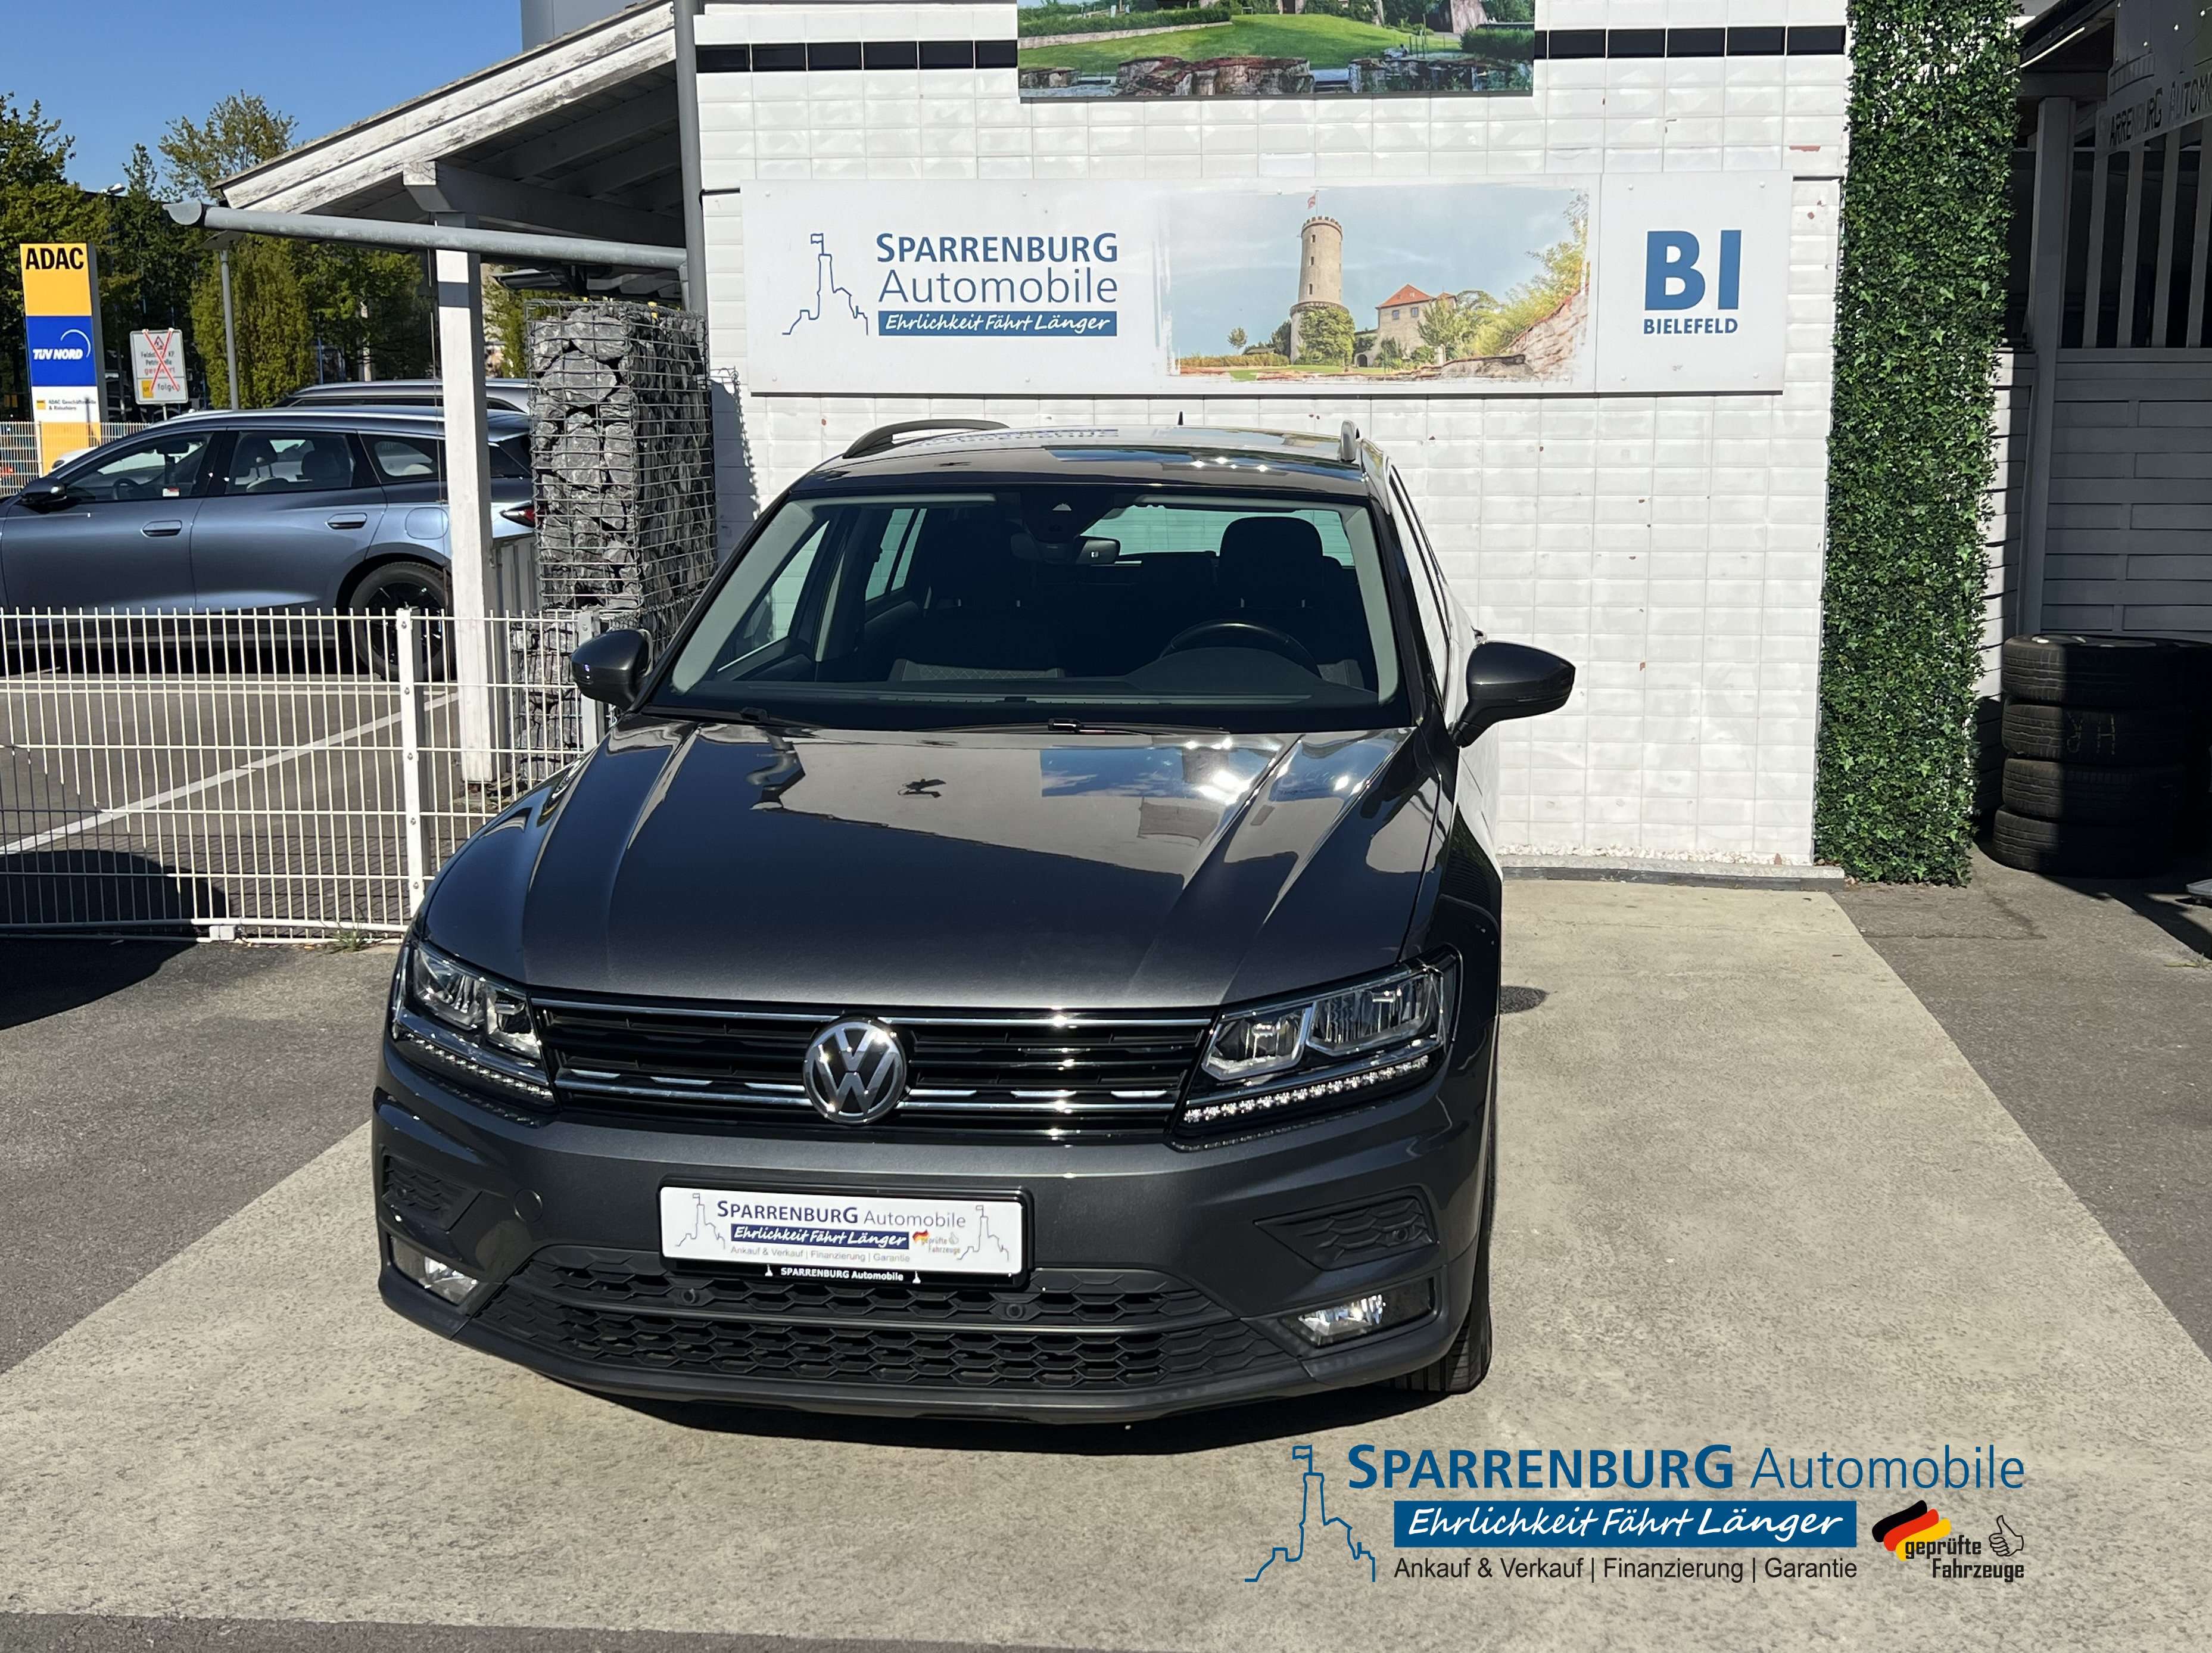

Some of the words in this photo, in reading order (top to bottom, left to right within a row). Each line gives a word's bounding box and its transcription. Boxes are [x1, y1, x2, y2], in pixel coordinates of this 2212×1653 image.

[26, 247, 84, 270] ADAC
[877, 233, 1118, 263] SPARRENBURG
[1645, 230, 1741, 311] BI
[878, 267, 1118, 303] Automobile
[885, 313, 985, 331] Ehrlichkeit
[985, 314, 1033, 331] Fährt
[1034, 314, 1110, 334] Länger
[1644, 318, 1738, 334] BIELEFELD
[33, 348, 53, 360] TÜV
[53, 348, 83, 360] NORD
[717, 1200, 858, 1224] SPARRENBURG
[864, 1210, 966, 1228] Automobile
[734, 1226, 810, 1243] Ehrlichkeit
[809, 1230, 847, 1244] Fährt
[848, 1231, 906, 1249] Länger
[921, 1235, 948, 1246] geprüfte
[731, 1246, 761, 1255] Ankauf
[762, 1247, 768, 1255] &
[771, 1247, 803, 1257] Verkauf
[811, 1250, 866, 1262] Finanzierung
[873, 1253, 910, 1262] Garantie
[929, 1245, 961, 1254] Fahrzeuge
[781, 1267, 849, 1278] SPARRENBURG
[851, 1271, 904, 1281] Automobile
